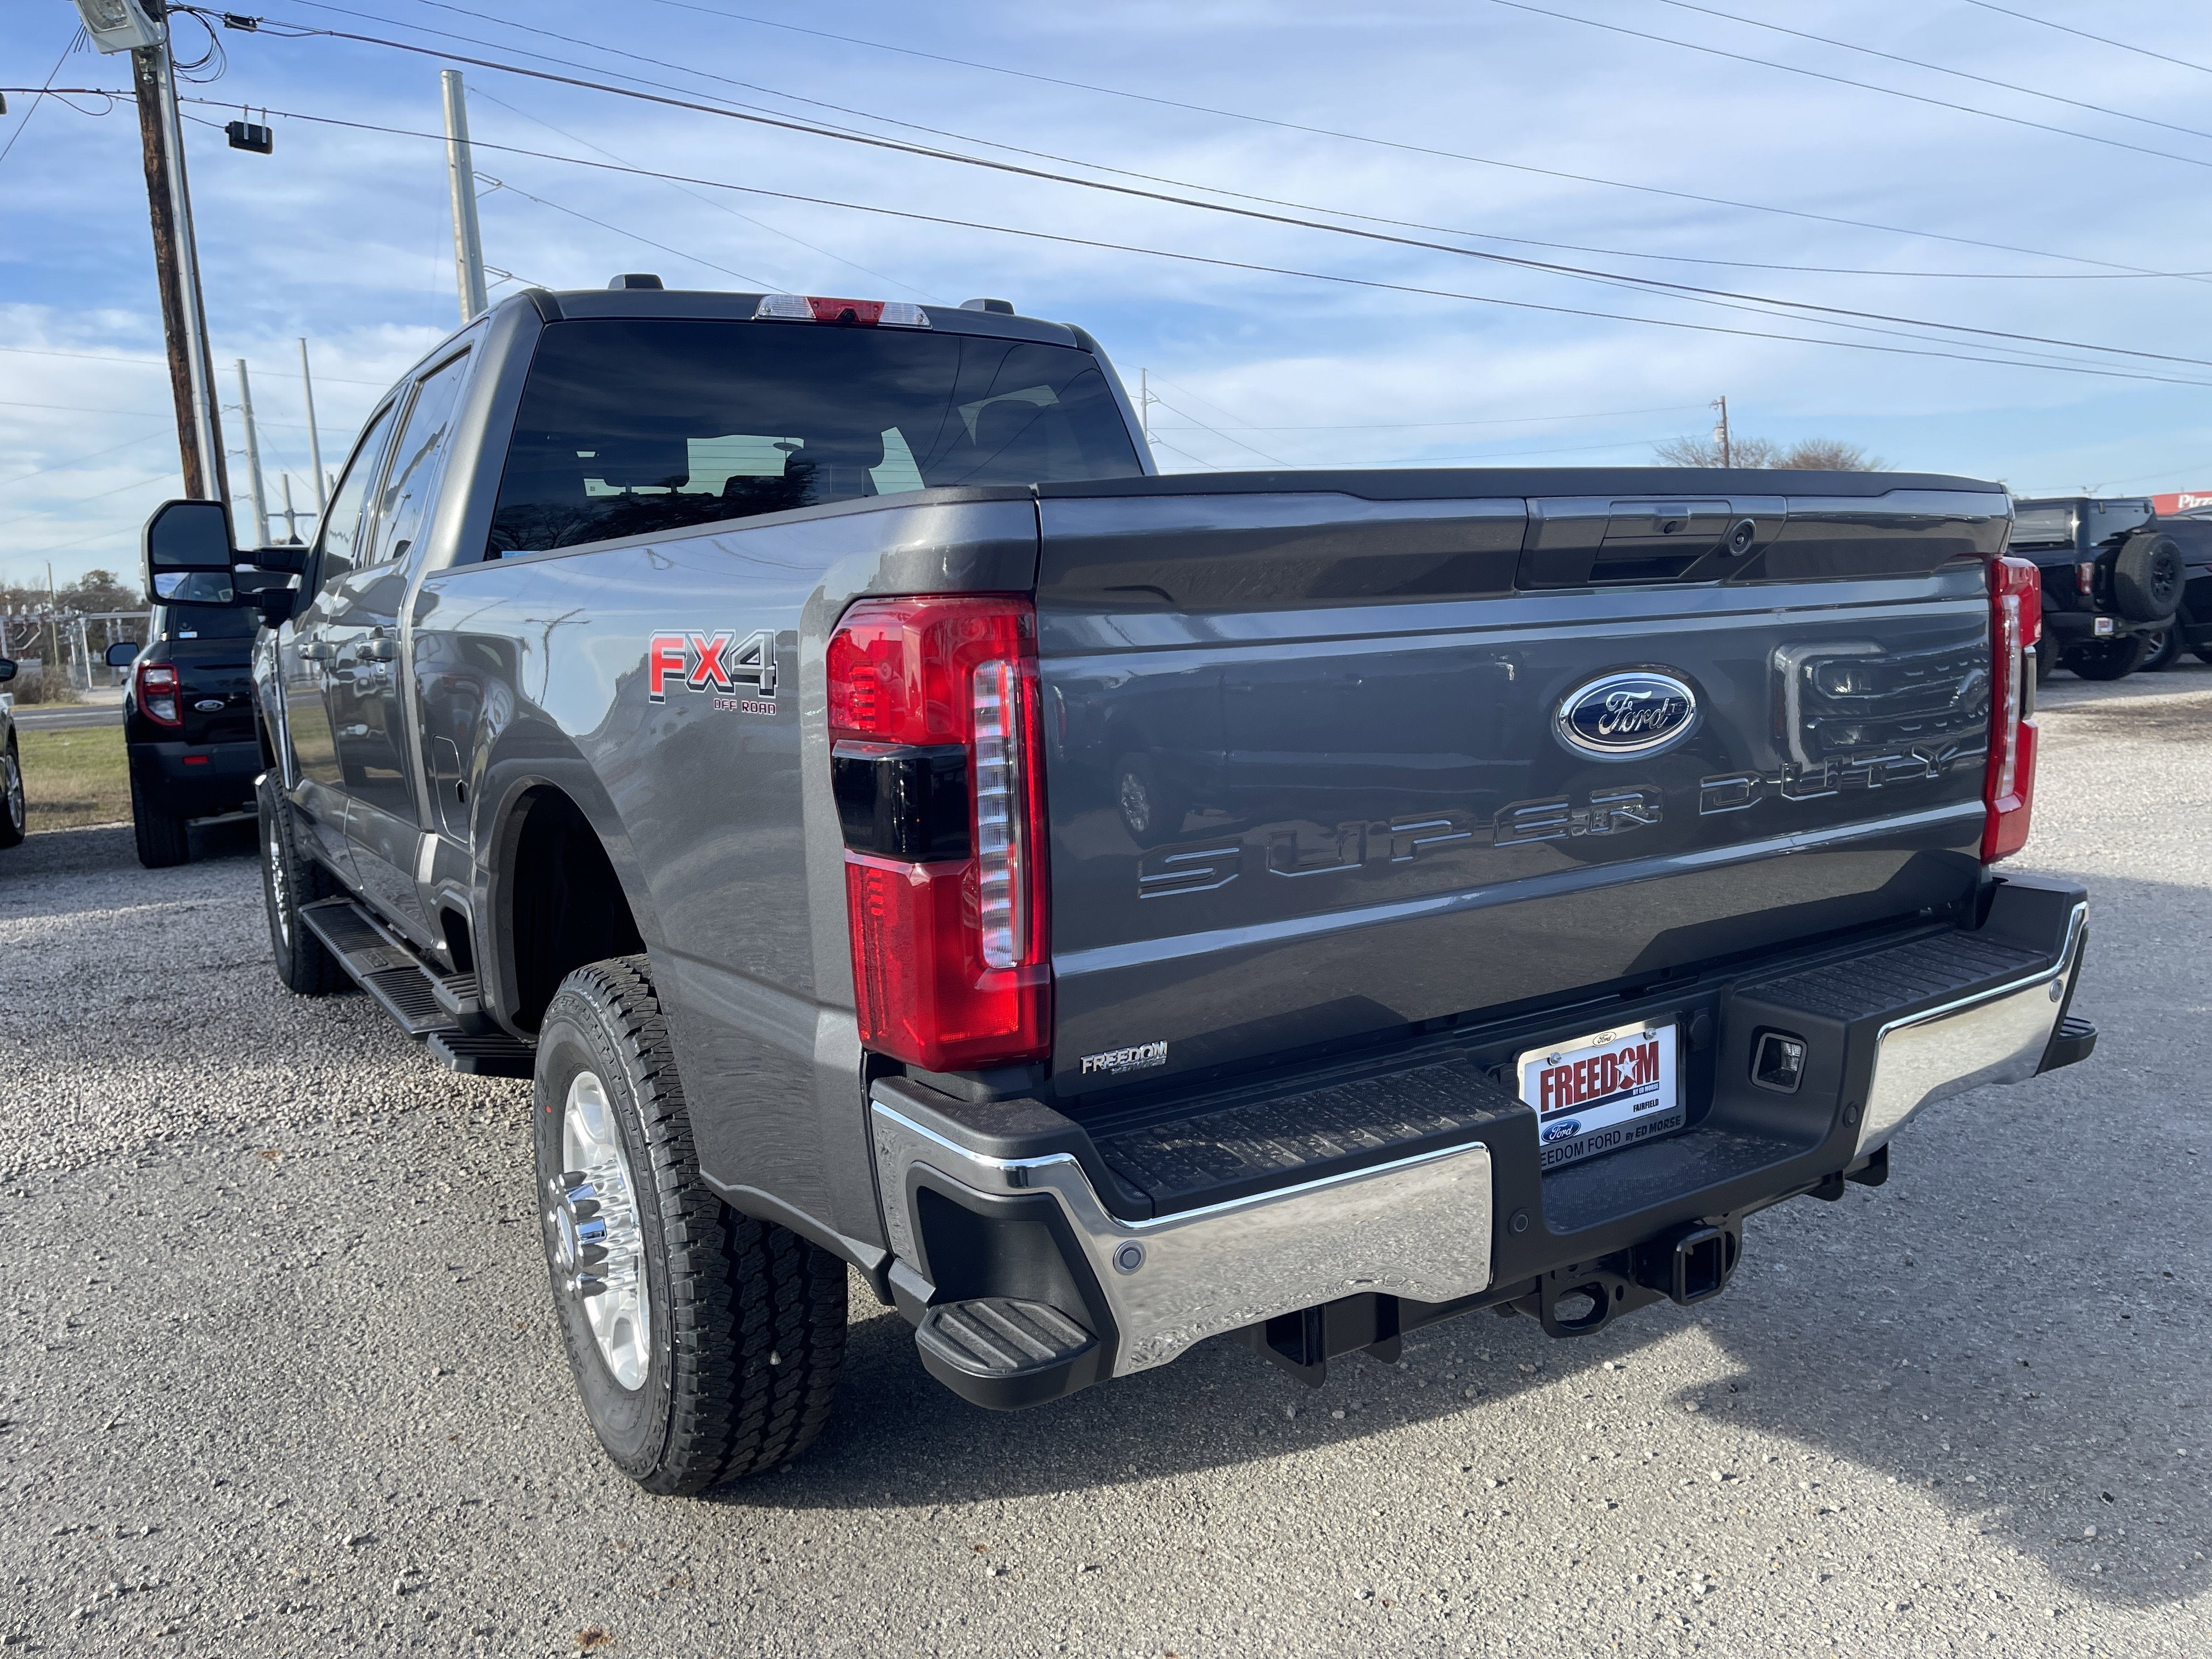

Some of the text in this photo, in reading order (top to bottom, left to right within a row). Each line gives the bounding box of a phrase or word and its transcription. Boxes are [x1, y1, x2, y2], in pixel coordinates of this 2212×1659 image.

[2179, 494, 2212, 509] Pizz
[649, 629, 777, 704] FX4
[714, 698, 777, 715] OFF ROAD
[1598, 690, 1670, 735] Ford
[1138, 738, 1960, 900] SUPER DUTY
[1080, 1040, 1167, 1074] FREEDOM
[1540, 1041, 1660, 1113] FREEDOM
[1645, 1083, 1659, 1092] MORSE
[1633, 1098, 1659, 1113] FAIRFIELD
[1549, 1123, 1574, 1140] Ford
[1588, 1130, 1621, 1153] FORD
[1635, 1125, 1647, 1138] ED
[1649, 1115, 1681, 1134] MORSE
